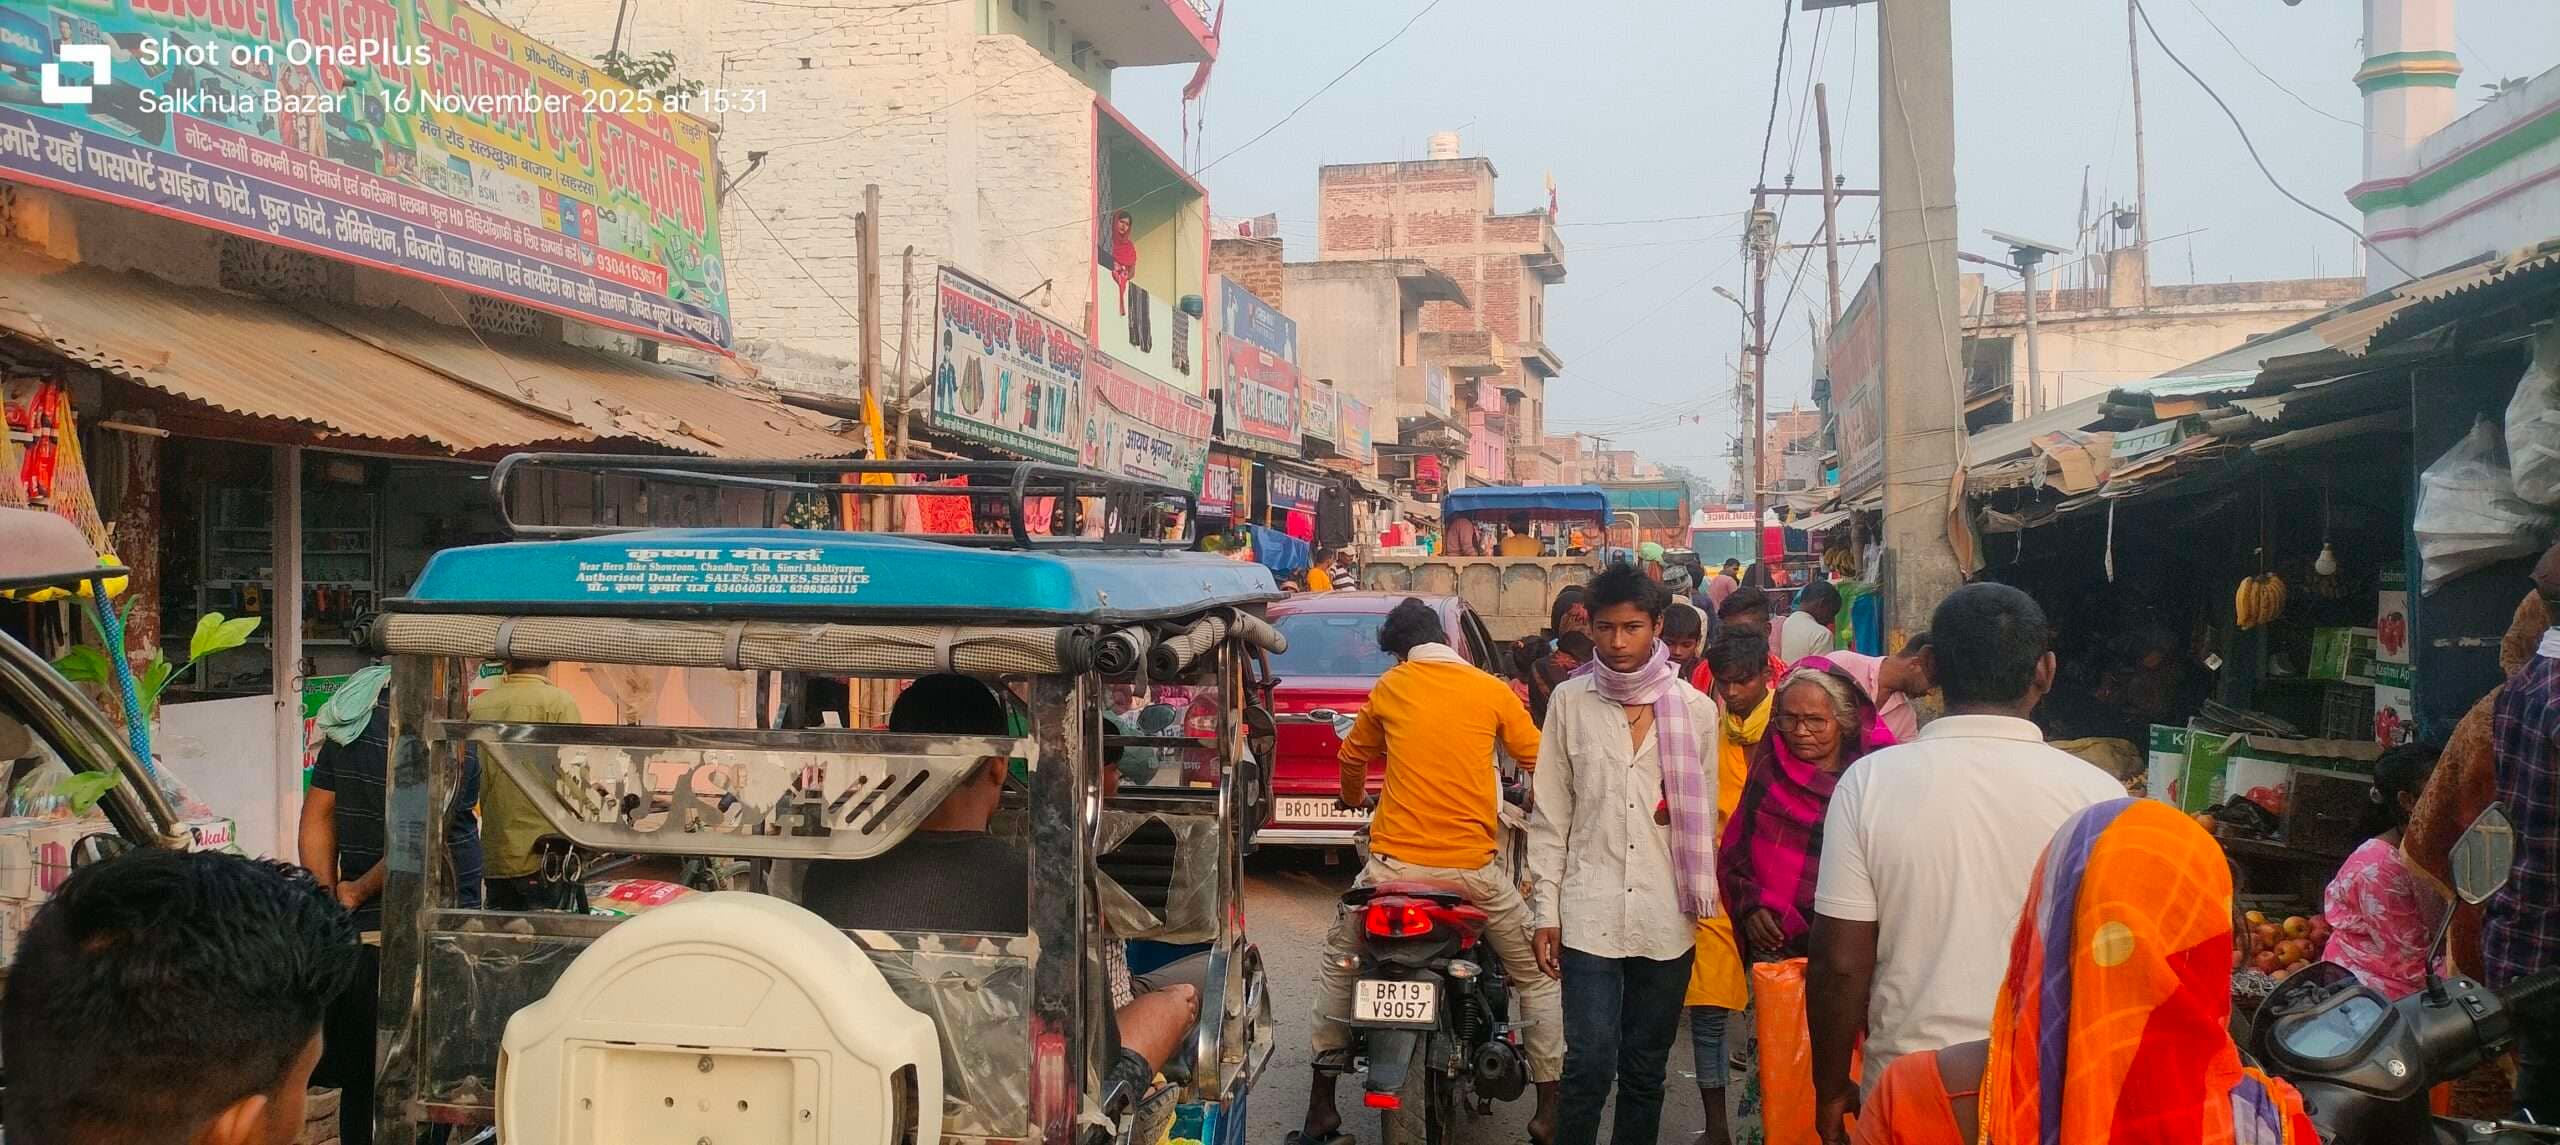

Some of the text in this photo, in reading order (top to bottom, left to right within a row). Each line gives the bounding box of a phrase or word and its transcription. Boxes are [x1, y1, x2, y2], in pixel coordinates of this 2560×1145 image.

[444, 128, 465, 149] रोड
[292, 161, 308, 182] का
[450, 206, 463, 227] HD
[43, 130, 84, 173] यहाँ
[86, 149, 157, 191] पासपोर्ट
[157, 162, 210, 204] साईज
[212, 174, 256, 219] फोटो,
[259, 194, 291, 235] फुल
[292, 197, 332, 240] फोटो,
[446, 246, 466, 271] का
[466, 250, 503, 282] सामान
[561, 279, 577, 301] का
[579, 562, 600, 572] Near
[602, 562, 624, 572] Hero
[576, 572, 645, 583] Authorised
[1376, 983, 1420, 1001] BR19
[1373, 1000, 1427, 1019] V9057
